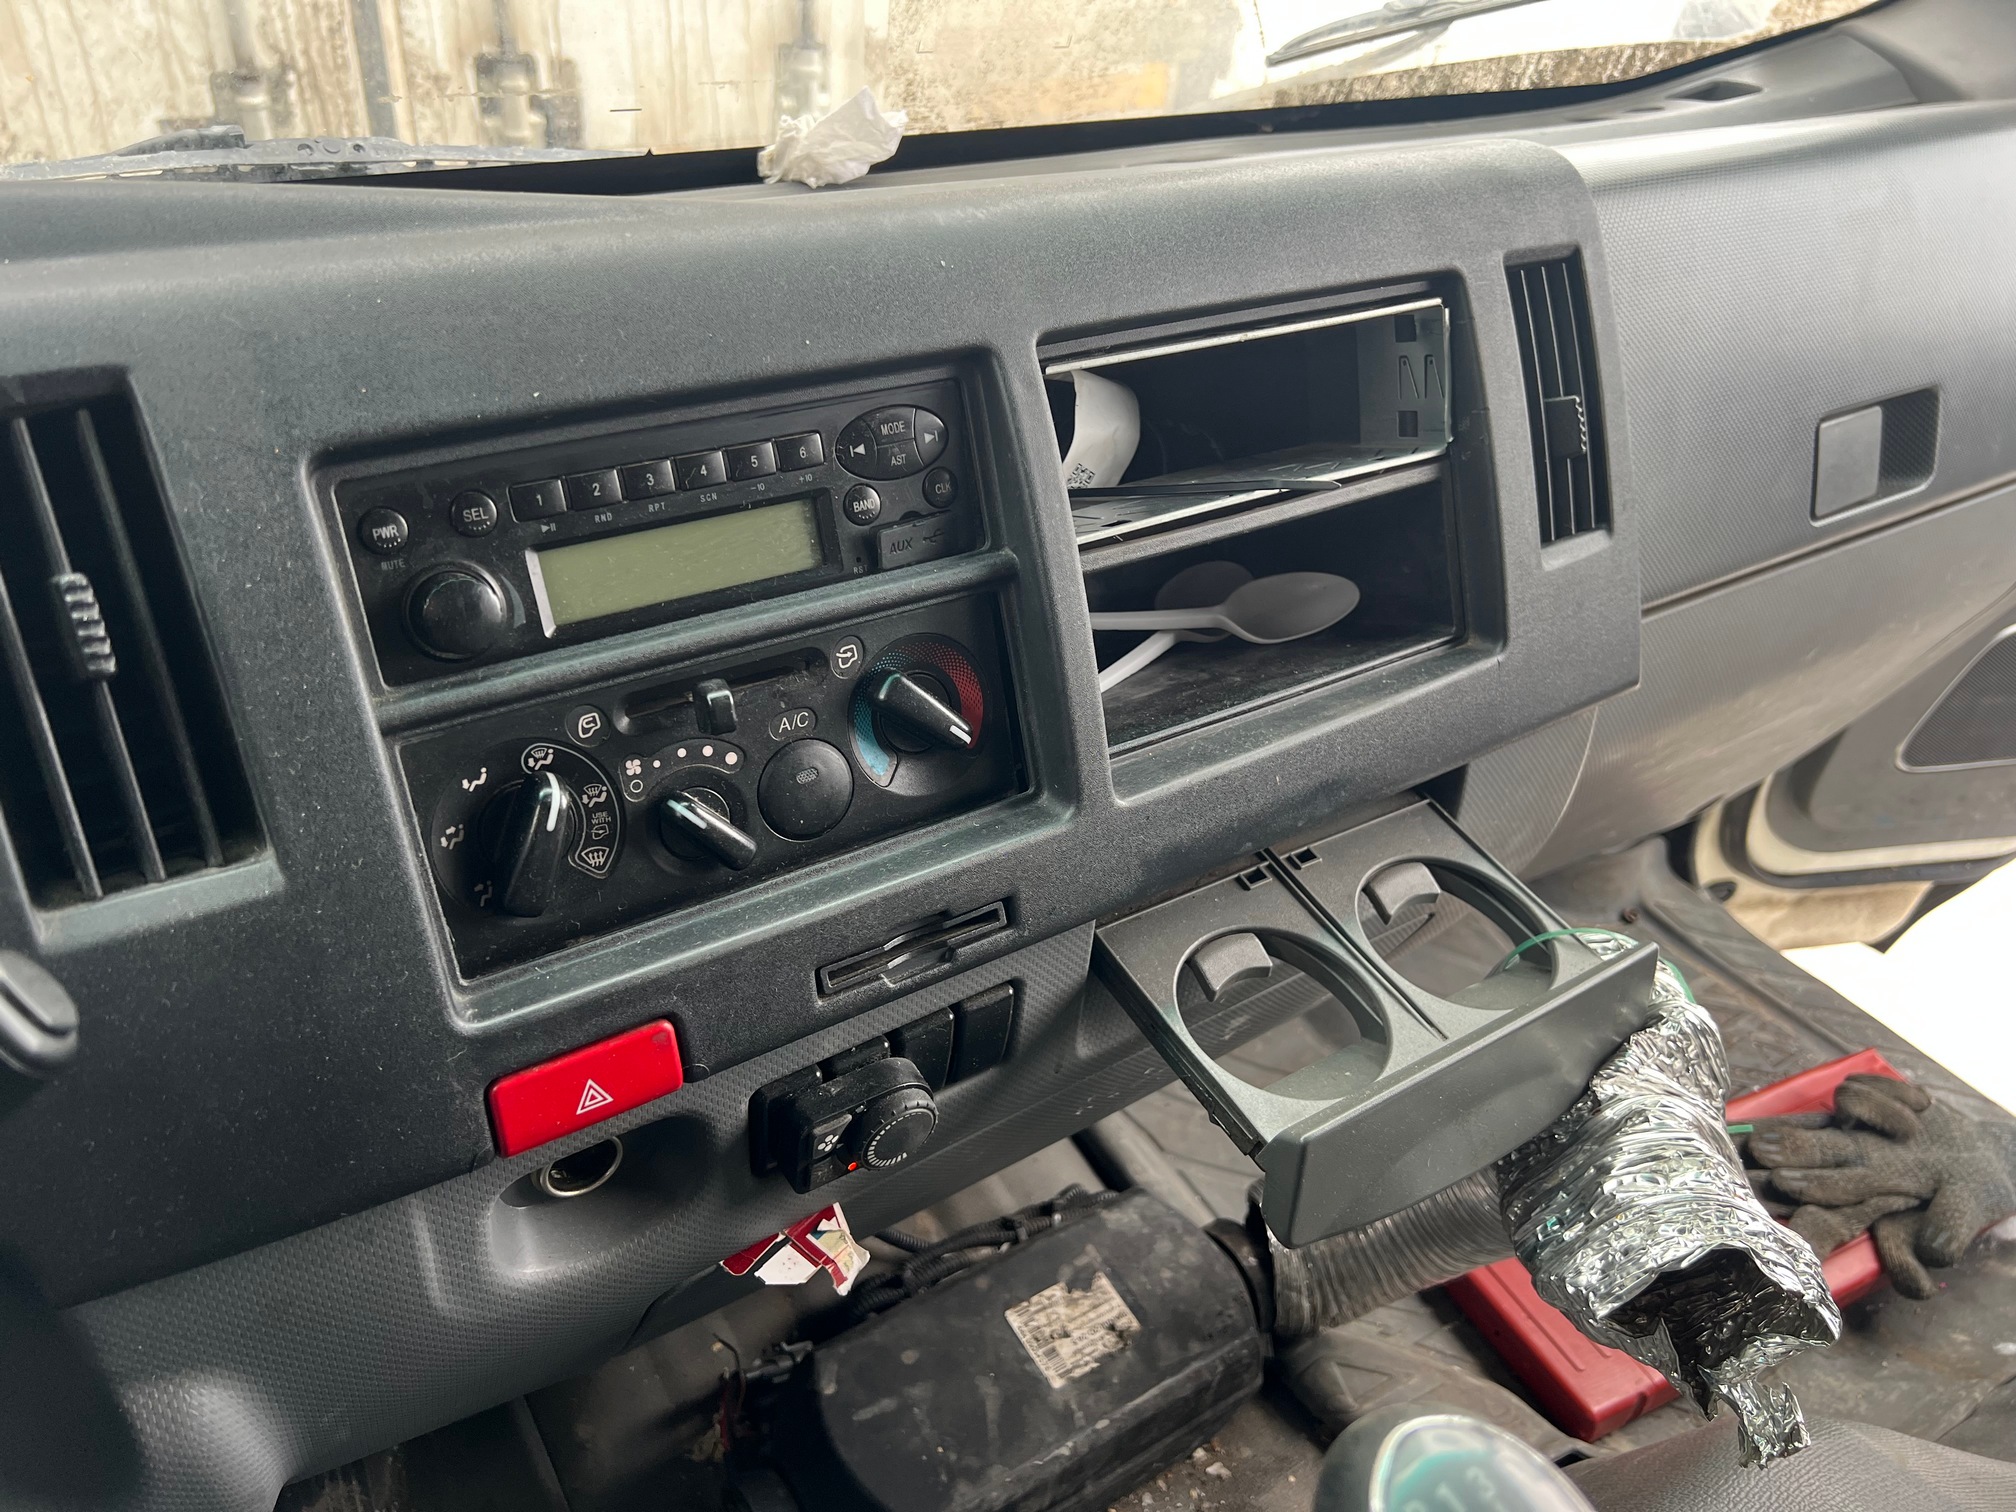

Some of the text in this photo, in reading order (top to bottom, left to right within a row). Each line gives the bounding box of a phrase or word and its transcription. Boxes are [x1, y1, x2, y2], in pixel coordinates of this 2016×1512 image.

[880, 421, 906, 436] MODE
[799, 446, 807, 459] 6
[750, 455, 759, 468] 5
[890, 453, 907, 467] AST
[700, 464, 708, 477] 4
[645, 473, 655, 486] 3
[592, 482, 601, 497] 2
[935, 481, 952, 494] CLK
[536, 493, 543, 507] 1
[699, 492, 718, 503] SCN
[648, 502, 666, 513] RPT
[852, 498, 876, 513] BAND
[462, 507, 489, 523] SEL
[594, 512, 613, 524] RND
[372, 524, 400, 541] PWR
[889, 537, 913, 555] AUX
[380, 558, 406, 571] MUTE
[853, 564, 868, 575] RST
[778, 711, 809, 733] A/C
[591, 816, 612, 825] WITH
[592, 810, 608, 819] USE
